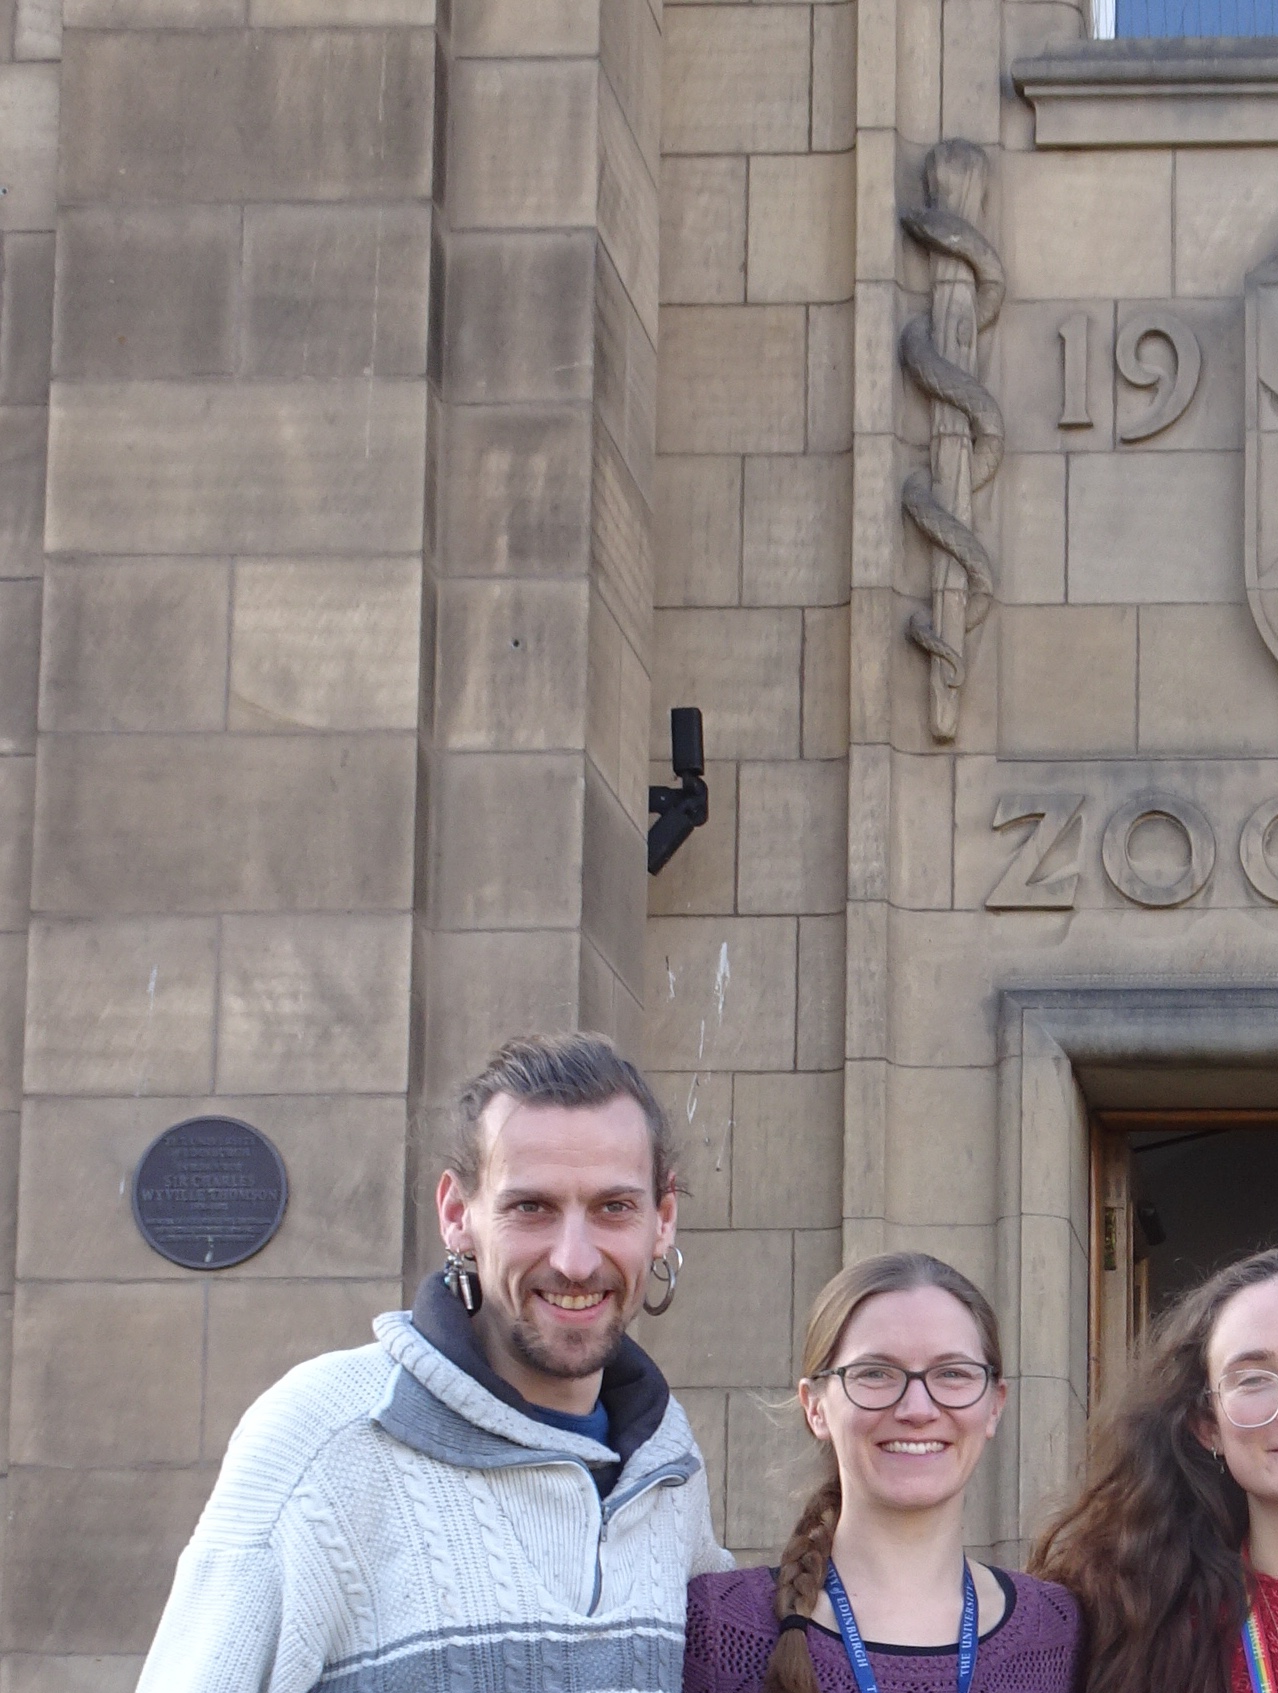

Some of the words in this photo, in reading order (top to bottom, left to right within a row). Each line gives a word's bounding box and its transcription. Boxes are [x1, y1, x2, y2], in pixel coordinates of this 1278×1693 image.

[1056, 308, 1202, 445] 19
[836, 1594, 869, 1668] EDINBURGH
[960, 1653, 971, 1678] THE
